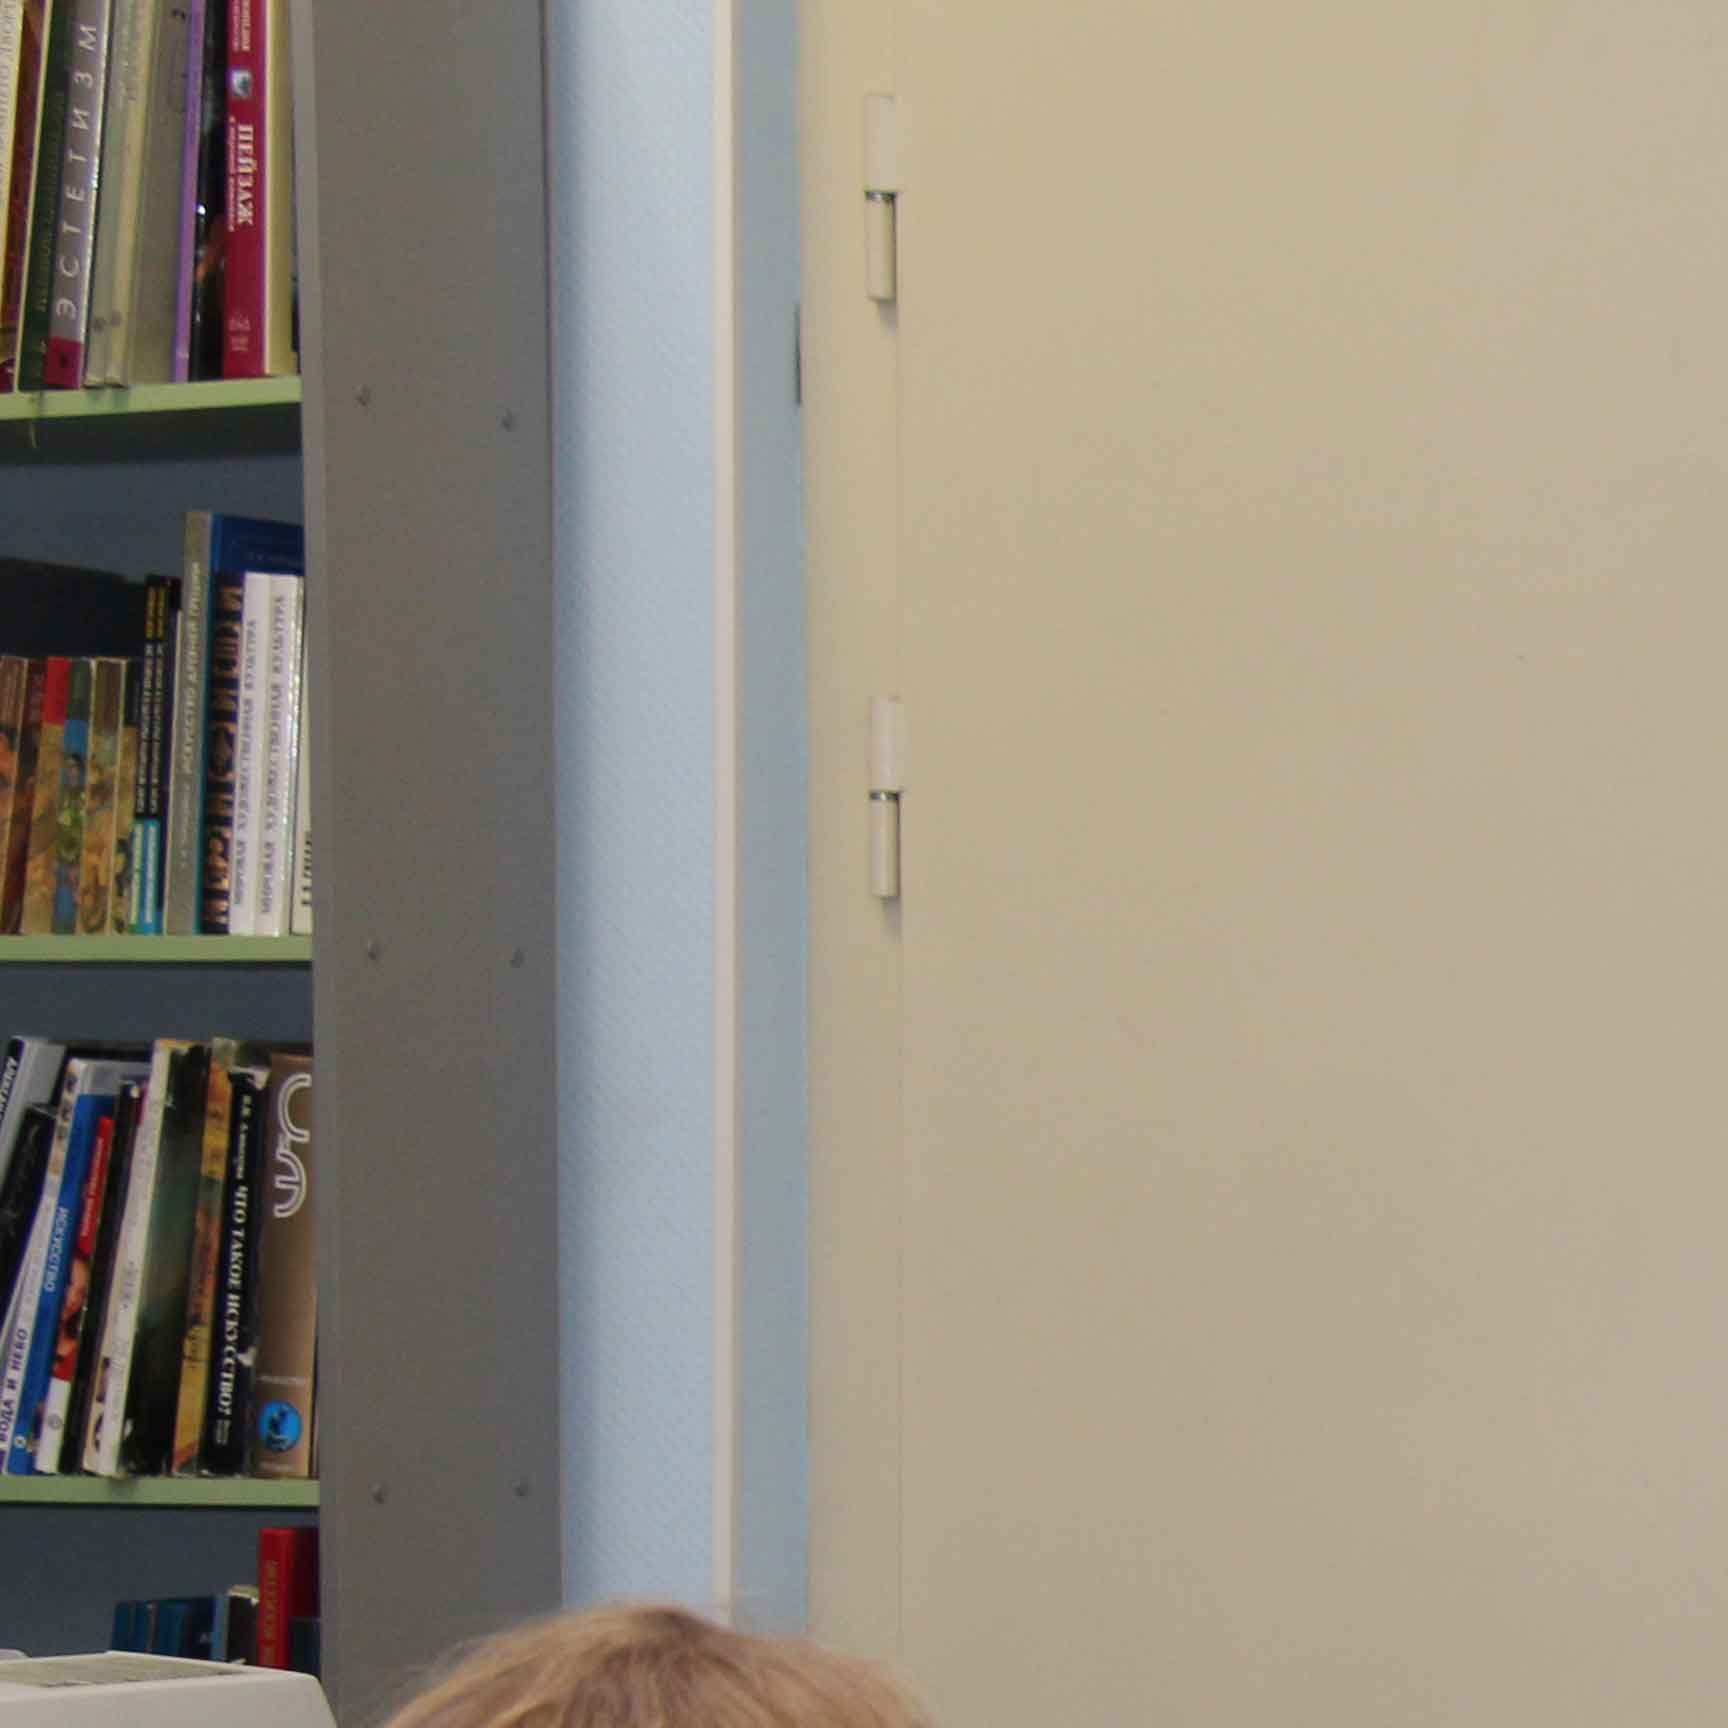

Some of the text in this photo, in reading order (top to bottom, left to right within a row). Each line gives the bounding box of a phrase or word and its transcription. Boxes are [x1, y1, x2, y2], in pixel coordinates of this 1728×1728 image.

[56, 25, 97, 320] ЭСТЕТИЗМ
[233, 1185, 249, 1224] ЧТО
[228, 1228, 246, 1290] ТАКОЕ
